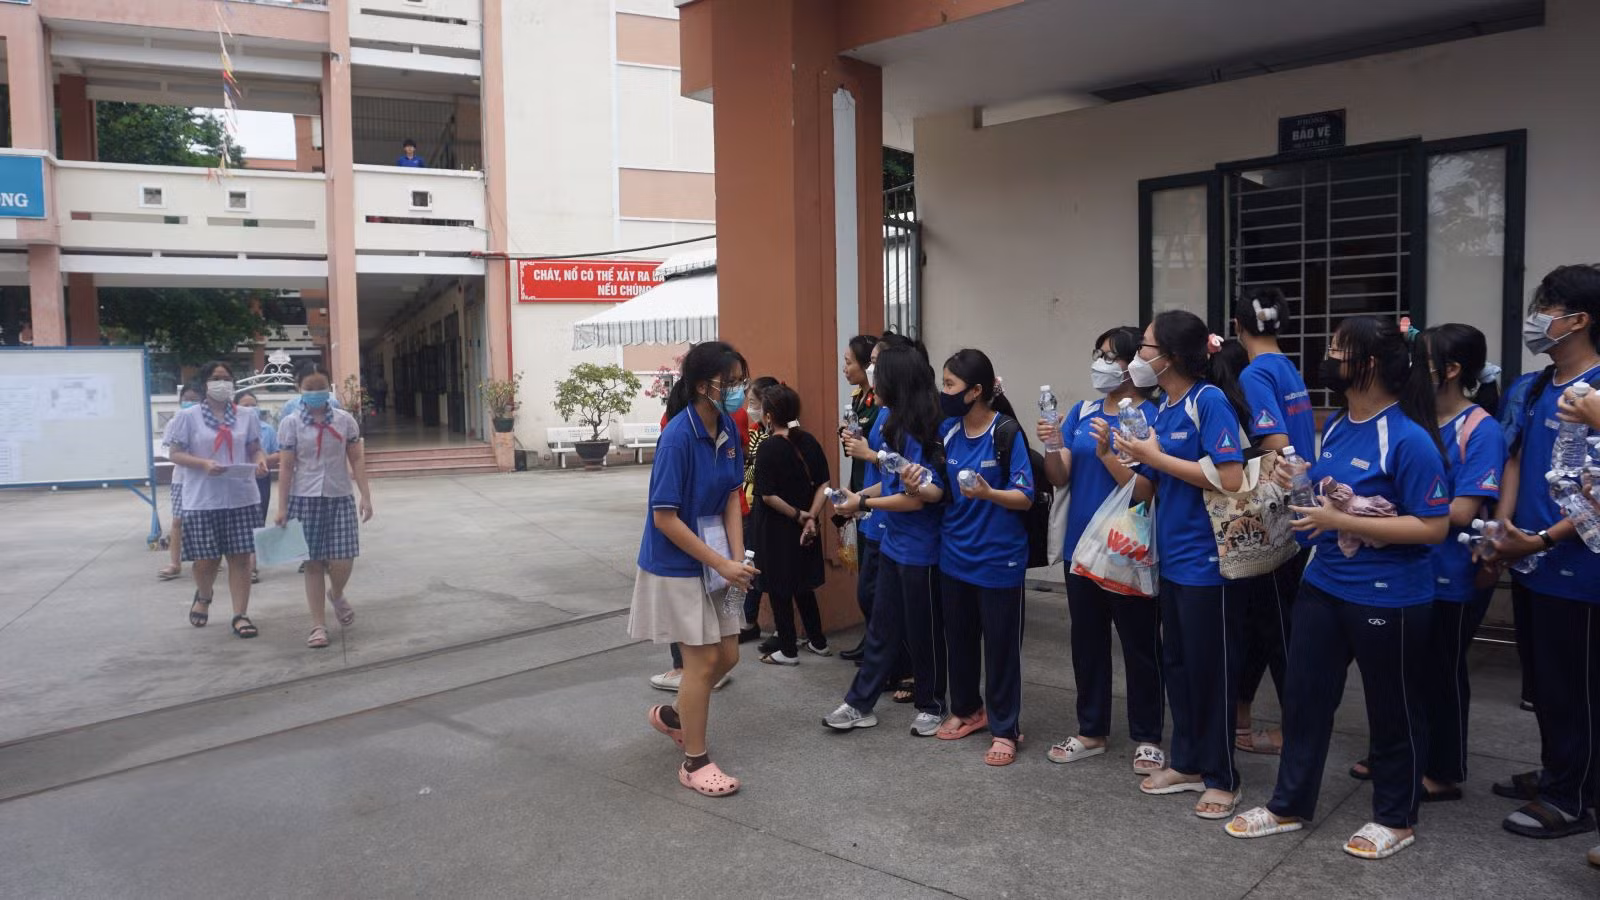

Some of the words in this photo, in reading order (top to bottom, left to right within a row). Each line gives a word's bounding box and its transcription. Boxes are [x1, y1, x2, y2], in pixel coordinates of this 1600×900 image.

[0, 192, 29, 208] NG
[533, 266, 561, 282] CHÁY,
[580, 267, 594, 281] CÓ
[637, 270, 651, 281] RA
[597, 281, 617, 296] NẾU
